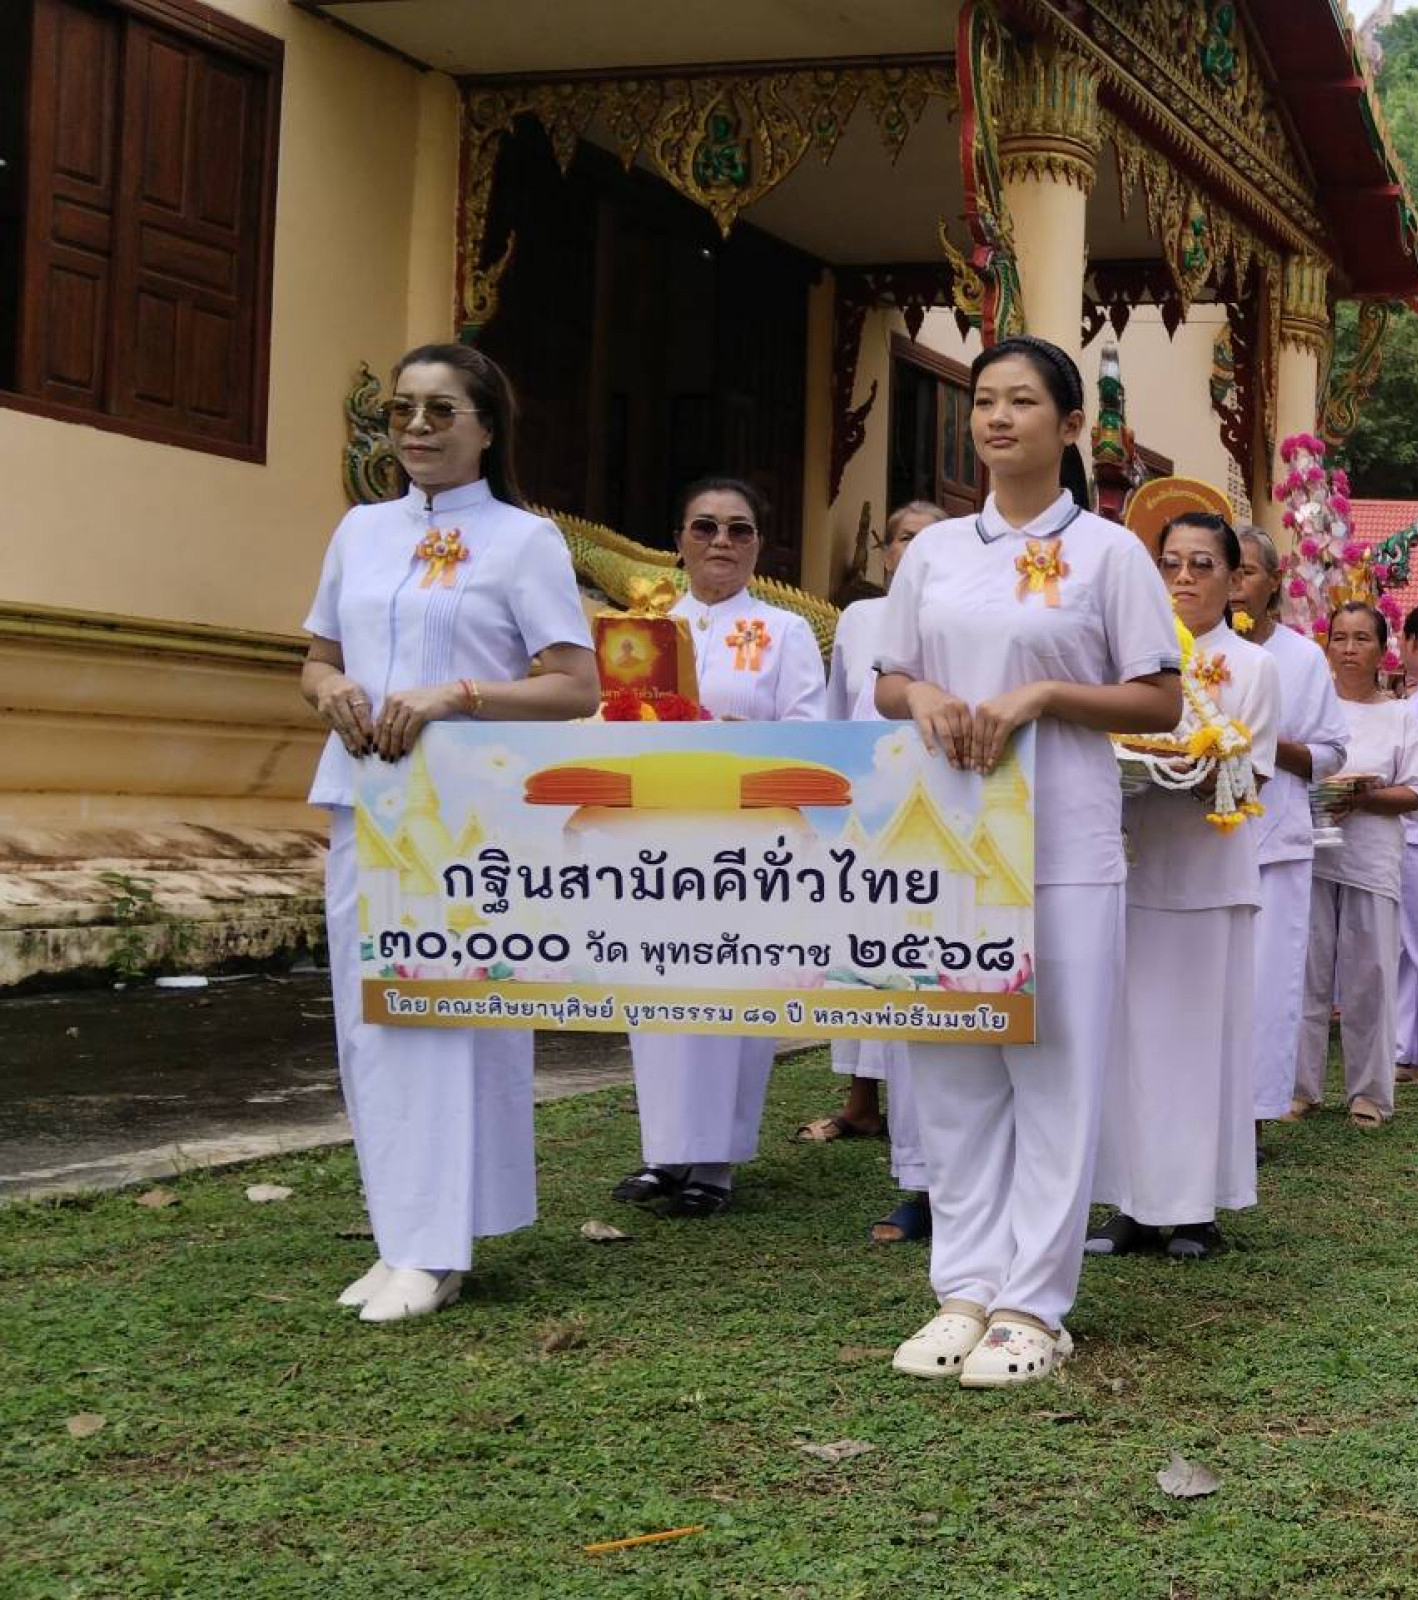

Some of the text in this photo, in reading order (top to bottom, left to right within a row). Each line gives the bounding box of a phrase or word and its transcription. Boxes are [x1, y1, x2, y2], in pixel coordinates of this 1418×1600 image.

[443, 836, 940, 914] กฐินสามัคคีทั่วไทย
[380, 930, 1016, 975] ๓๐,๐๐๐ วัด พุทธศักราช ๒๕๖๘
[386, 992, 1006, 1029] โดย คณะศิษยานุศิษย์ บูชาธรรม ๘๑ ปี หลวงพ่อธัมมชโย
